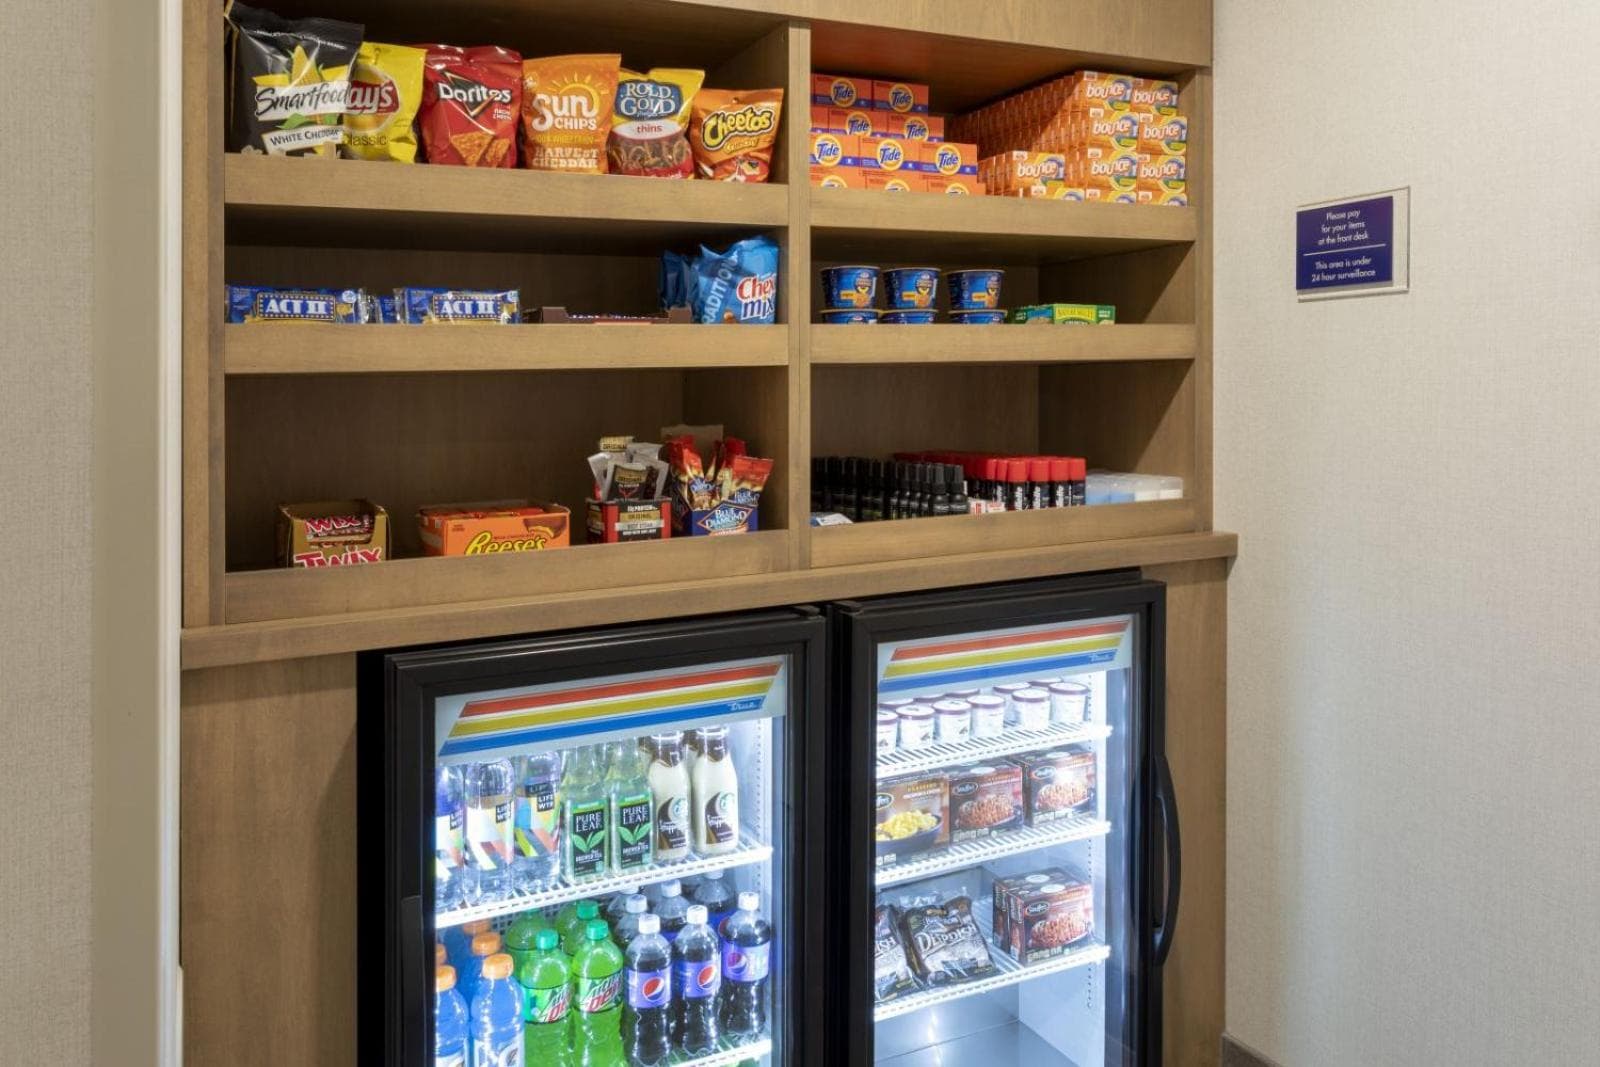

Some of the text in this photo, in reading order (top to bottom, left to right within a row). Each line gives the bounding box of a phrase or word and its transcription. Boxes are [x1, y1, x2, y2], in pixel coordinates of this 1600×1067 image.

[347, 83, 394, 114] ay's
[437, 81, 513, 104] Doritos
[625, 82, 673, 99] ROLD
[833, 85, 854, 101] Tide
[891, 89, 913, 106] Tide
[1086, 81, 1126, 99] bounce
[1132, 89, 1170, 104] bounce
[255, 83, 350, 117] Smartfood
[620, 96, 677, 116] GOLD
[532, 93, 600, 131] Sun
[554, 118, 598, 131] CHIPS
[636, 125, 663, 133] thins
[703, 107, 772, 148] Cheetos
[848, 119, 870, 136] Tide
[905, 124, 928, 141] Tide
[1092, 119, 1132, 136] bounce
[1143, 124, 1180, 140] bounce
[270, 130, 304, 146] WHITE
[534, 147, 599, 158] HARVEST
[815, 143, 840, 160] Tide
[879, 147, 902, 164] Tide
[937, 151, 960, 168] Tide
[532, 157, 598, 169] CHEDDAR
[1016, 162, 1058, 179] bounce
[1091, 159, 1131, 177] bounce
[1141, 165, 1178, 179] bounce
[1326, 209, 1361, 221] Please pay
[1321, 220, 1366, 234] for your items
[1326, 236, 1336, 245] the
[1337, 234, 1353, 243] front
[1353, 230, 1369, 241] desk
[1315, 255, 1372, 270] This area is under
[1311, 268, 1376, 283] 24 hour surveillance
[737, 276, 776, 301] Chex
[265, 298, 304, 315] ACT
[305, 300, 327, 315] II
[441, 300, 496, 315] ACT II
[741, 298, 774, 319] mix
[464, 530, 546, 556] Reese's
[576, 812, 602, 823] PURE
[623, 804, 649, 815] PURE
[576, 820, 602, 832] LEAF
[623, 812, 648, 825] LEAF
